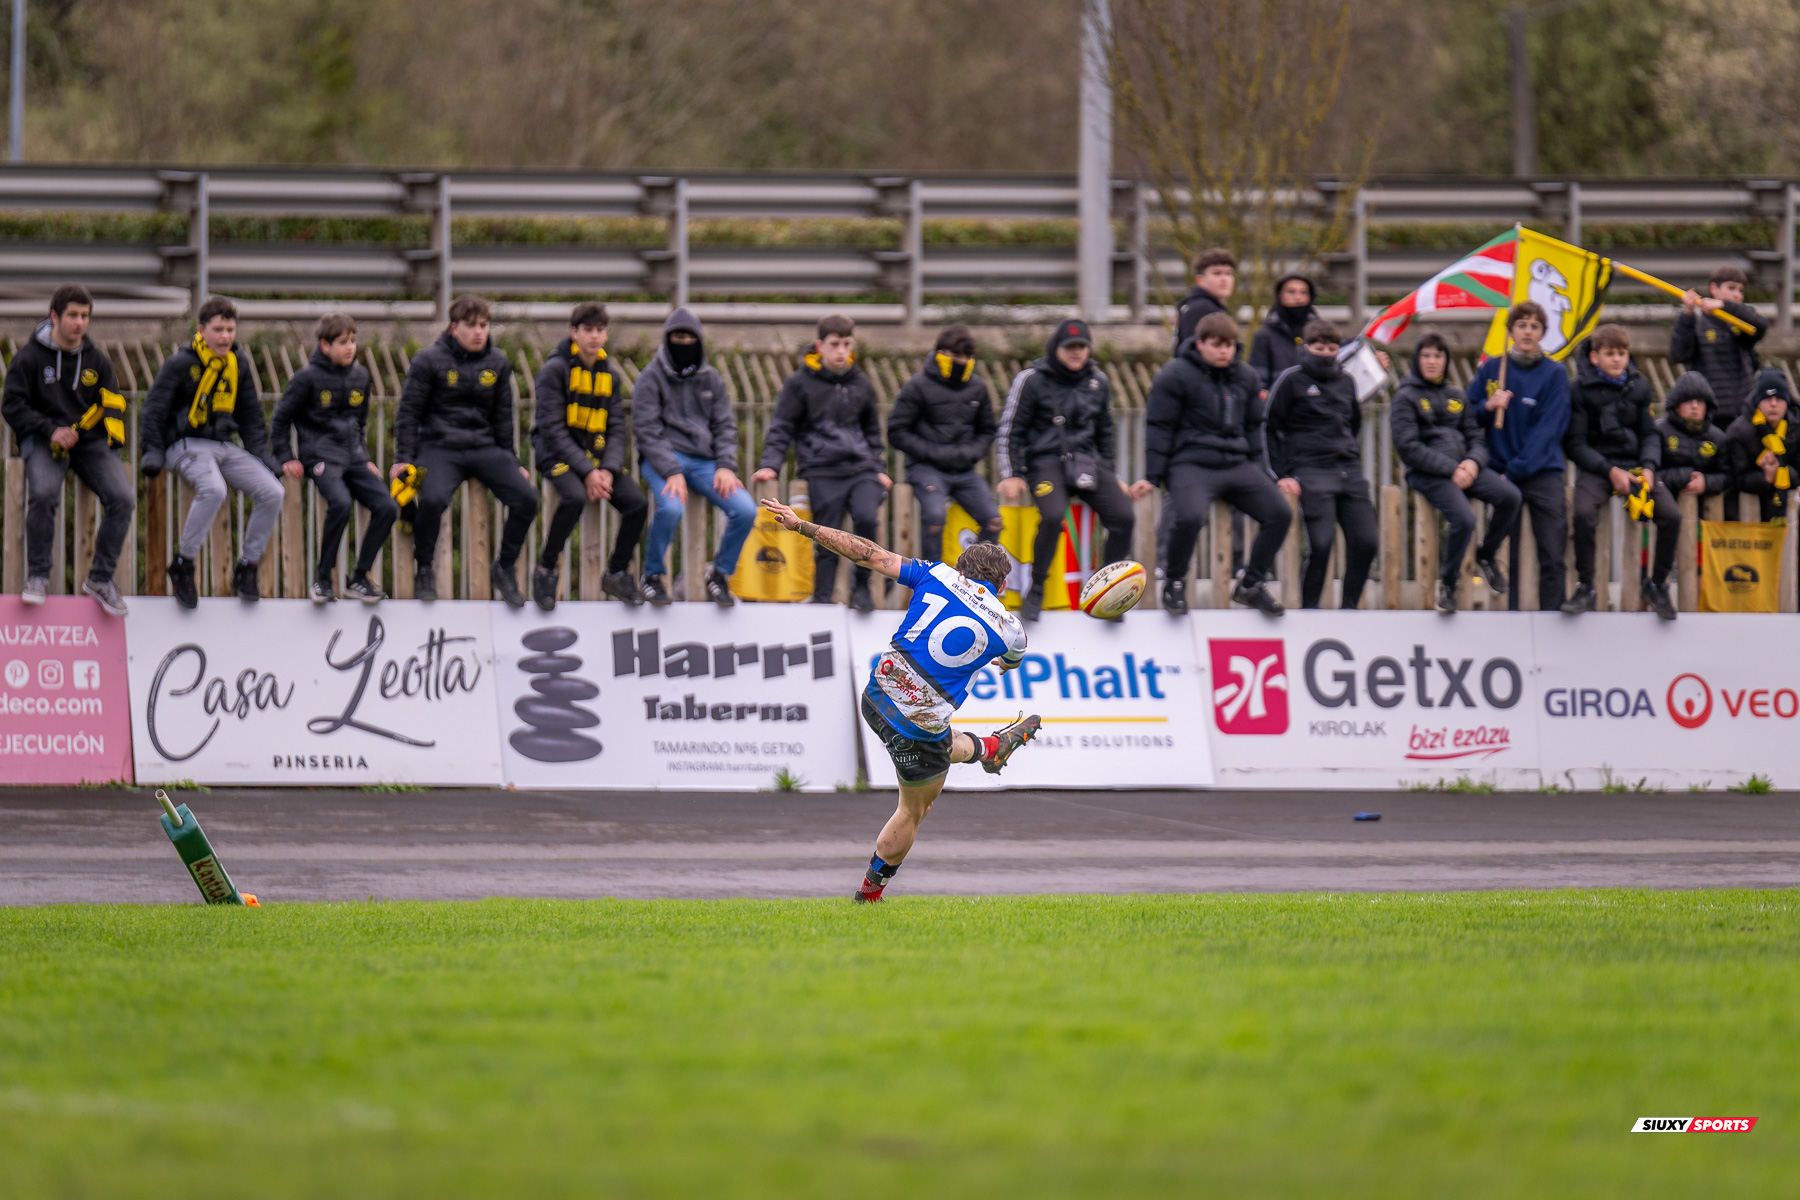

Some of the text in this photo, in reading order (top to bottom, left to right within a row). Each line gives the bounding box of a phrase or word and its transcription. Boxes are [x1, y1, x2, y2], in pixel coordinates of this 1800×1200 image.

[904, 592, 989, 668] 10
[611, 627, 835, 680] Harri
[1304, 637, 1523, 709] Getxo
[147, 613, 481, 762] Casa Leotta
[643, 692, 808, 722] Taberna
[1544, 687, 1800, 718] GIROA VEO
[1080, 735, 1175, 748] SOLUTIONS
[1309, 720, 1388, 737] KIROLAK
[1408, 724, 1511, 751] bizi ezazu
[0, 730, 104, 756] JECUCIÓN
[652, 739, 731, 755] TAMARINDO
[761, 741, 805, 756] GETXO
[273, 754, 369, 769] PINSERIA
